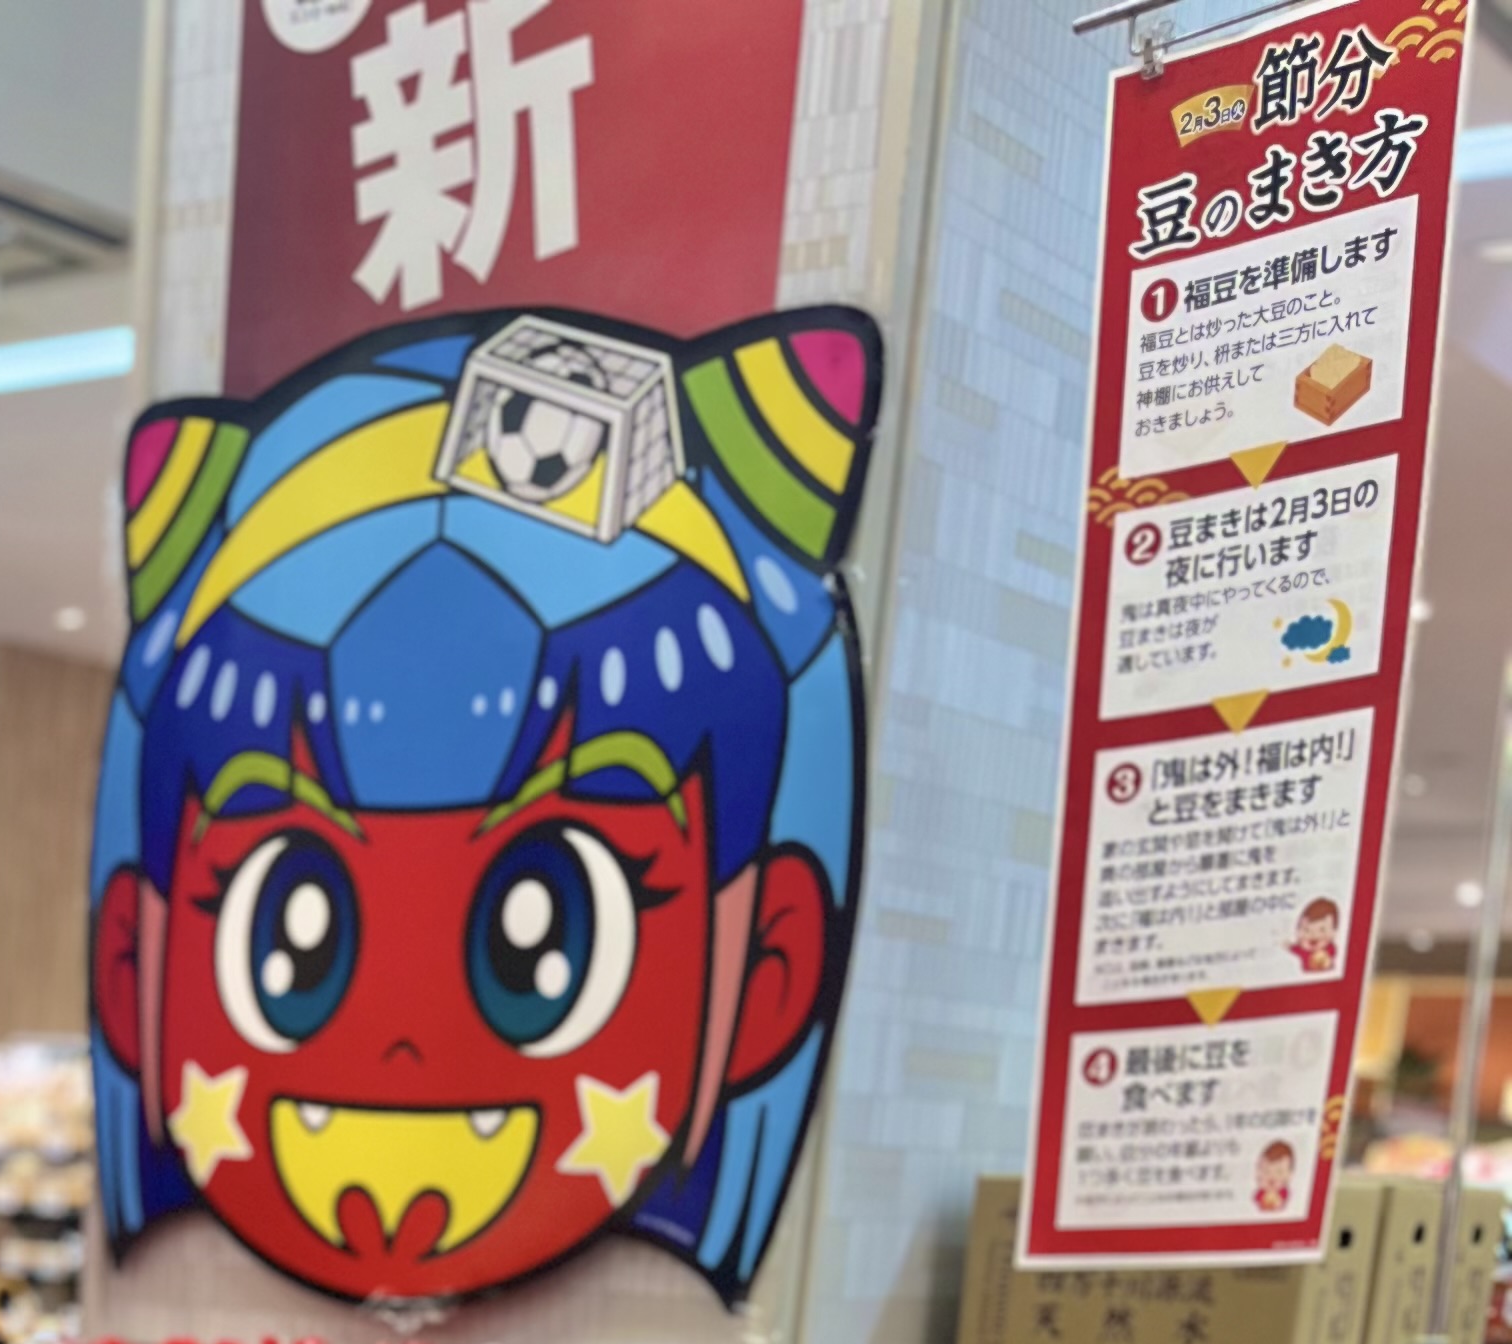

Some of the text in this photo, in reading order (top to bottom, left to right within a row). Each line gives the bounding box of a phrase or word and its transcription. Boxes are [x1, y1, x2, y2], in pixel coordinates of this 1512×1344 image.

[1254, 31, 1393, 131] 節分
[350, 0, 593, 309] 新
[1133, 114, 1426, 255] 豆のまき方
[1184, 226, 1399, 313] 福豆を準備します
[1137, 306, 1378, 383] 豆を炒り、枡または三方に入れて
[1139, 291, 1341, 353] 福豆とは炒った大豆のこと。
[1136, 364, 1264, 410] 神棚にお供えして
[1134, 407, 1235, 437] おきましょう。
[1167, 478, 1379, 551] 豆まきは2月3日の
[1164, 529, 1318, 588] 夜に行います
[1118, 614, 1219, 650] 豆まきは夜が
[1147, 775, 1322, 827] と豆をまきます
[1124, 1037, 1250, 1076] 最後に豆を
[1121, 1077, 1222, 1110] 食べます
